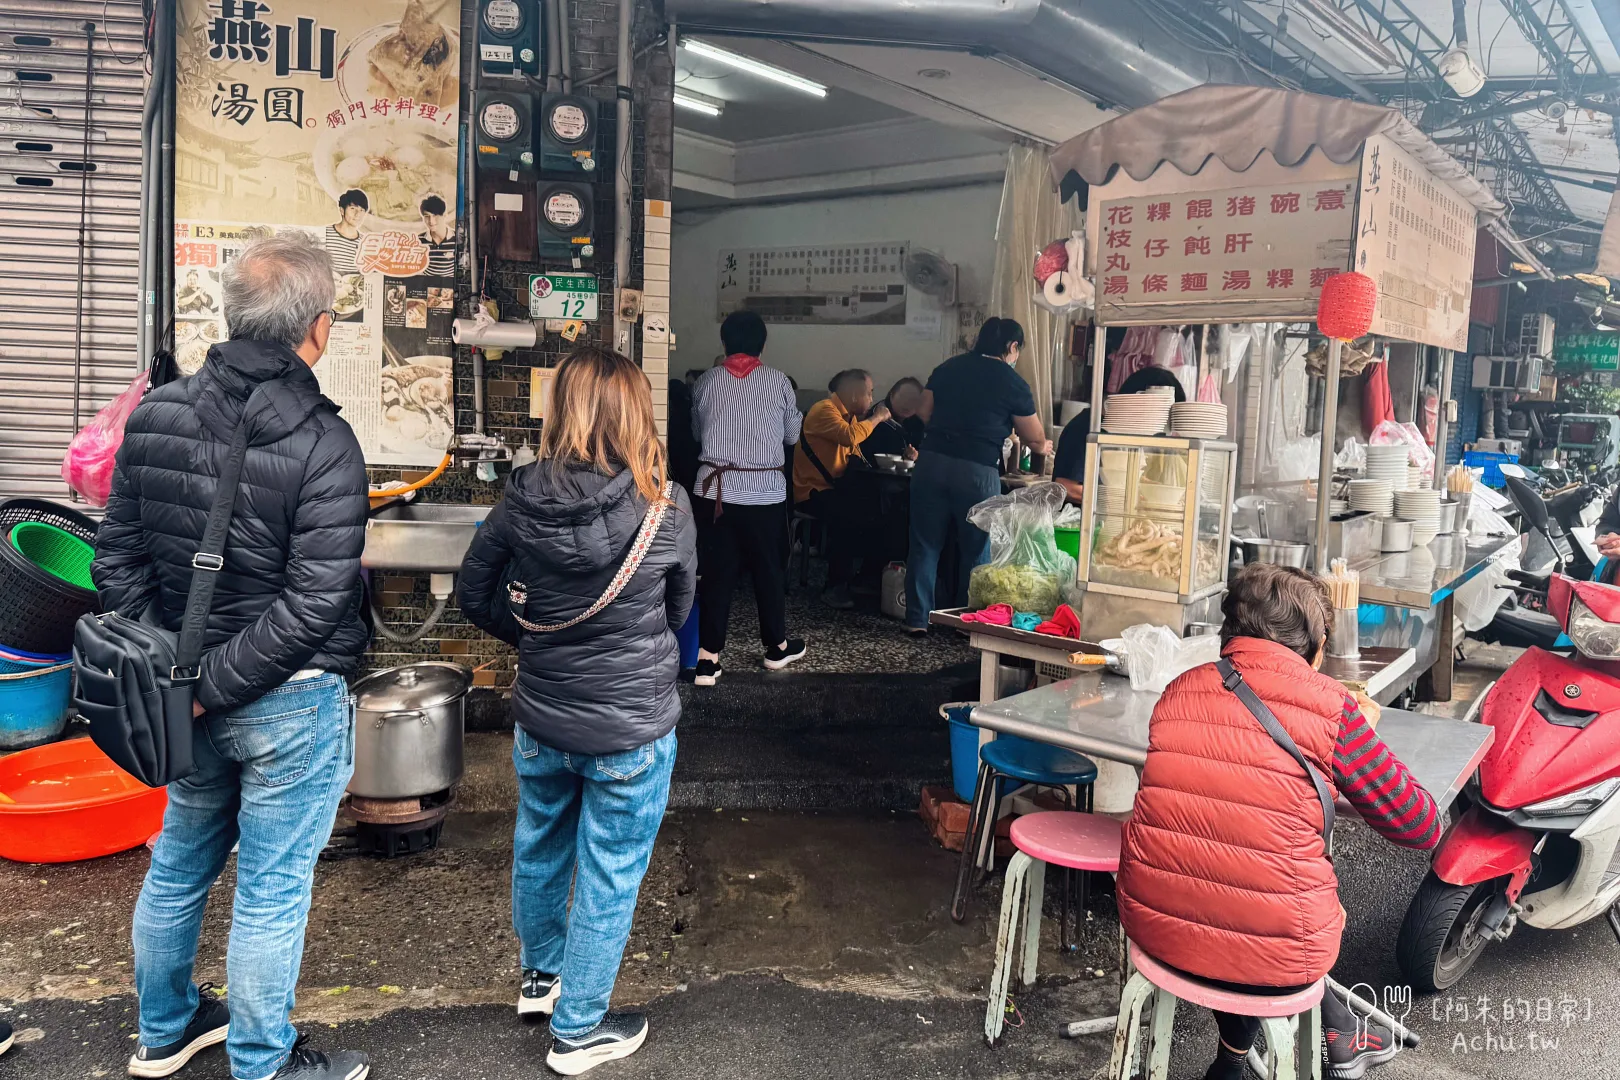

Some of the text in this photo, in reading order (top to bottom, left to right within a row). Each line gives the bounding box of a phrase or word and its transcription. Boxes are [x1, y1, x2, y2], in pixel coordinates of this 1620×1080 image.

[207, 0, 337, 79] 燕山
[195, 226, 214, 238] E3
[1103, 205, 1133, 295] 花枝丸湯
[1141, 202, 1171, 294] 粿仔條
[1180, 199, 1212, 292] 餛飩麵
[554, 277, 597, 290] 民生西路
[561, 299, 585, 318] 12
